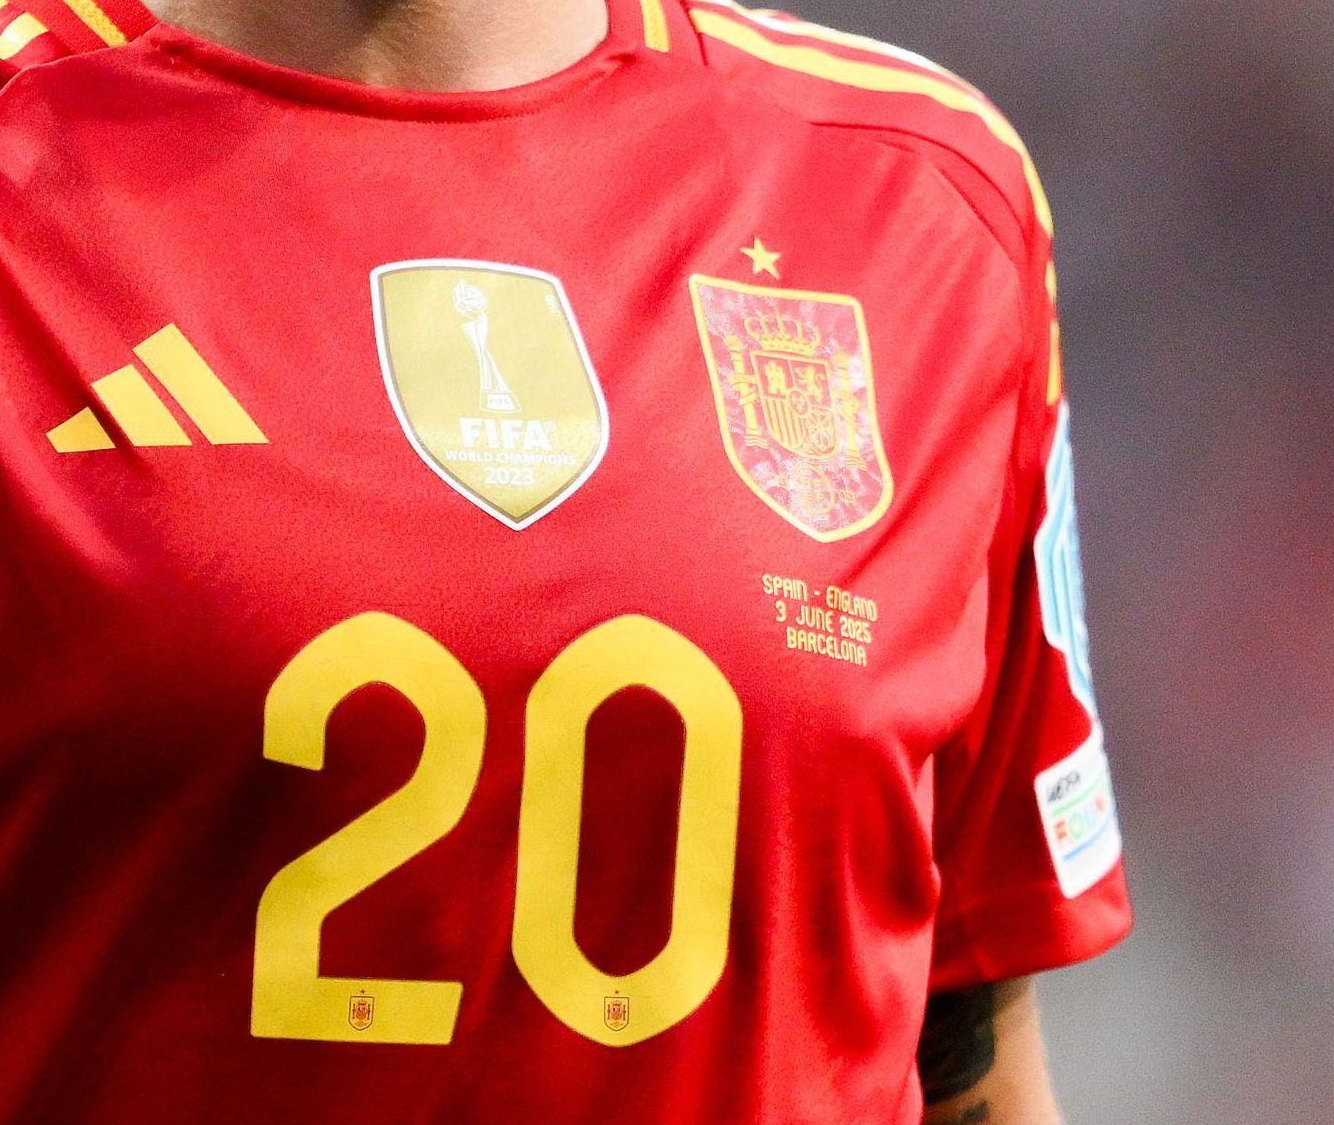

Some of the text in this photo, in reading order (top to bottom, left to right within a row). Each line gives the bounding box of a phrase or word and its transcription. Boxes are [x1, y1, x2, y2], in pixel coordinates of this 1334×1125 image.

[445, 450, 492, 463] WORLD
[484, 466, 535, 486] 2023
[762, 574, 807, 602] SPAIN
[826, 586, 878, 622] ENGLAND
[775, 600, 872, 644] 3 JUNE 2025
[786, 626, 867, 667] BARCELONA
[251, 611, 743, 1047] 20
